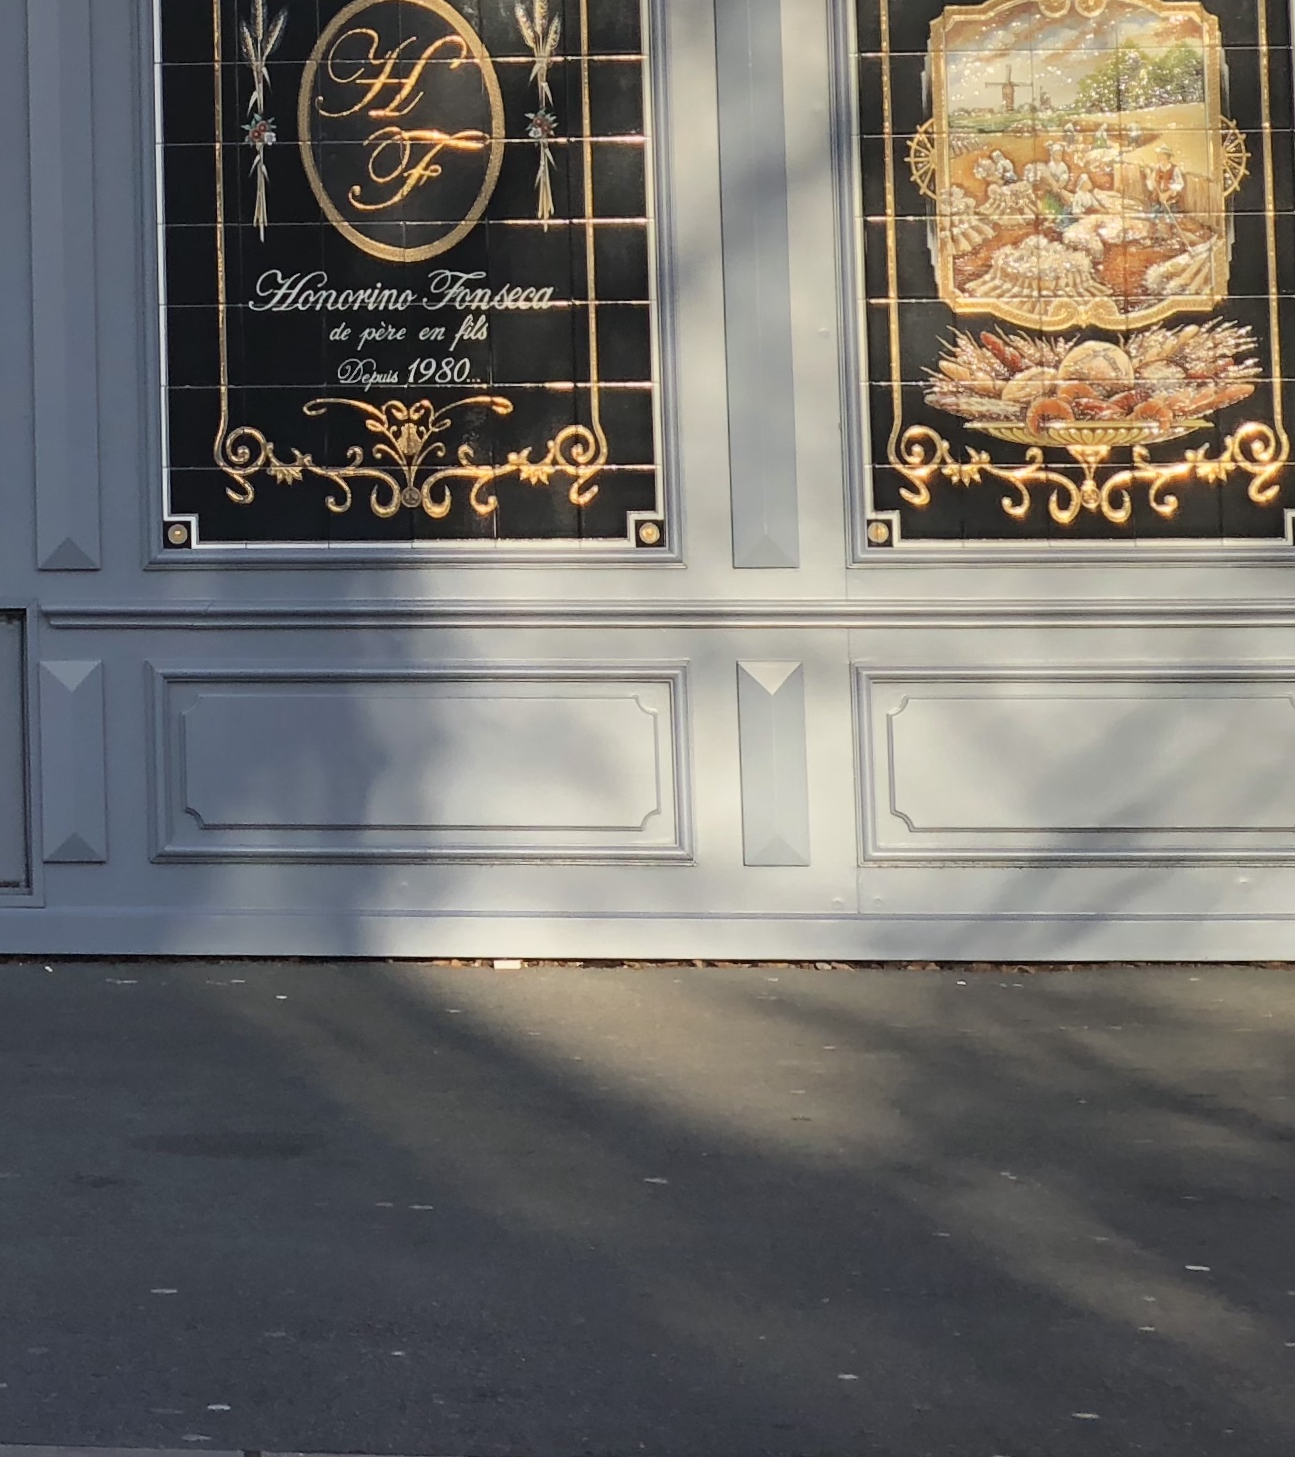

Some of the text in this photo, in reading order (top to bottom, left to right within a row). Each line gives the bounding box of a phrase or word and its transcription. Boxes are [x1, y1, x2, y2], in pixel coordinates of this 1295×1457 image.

[248, 269, 555, 312] Honorino Fonseca
[329, 313, 489, 351] de père en fils
[337, 358, 399, 392] Depuis
